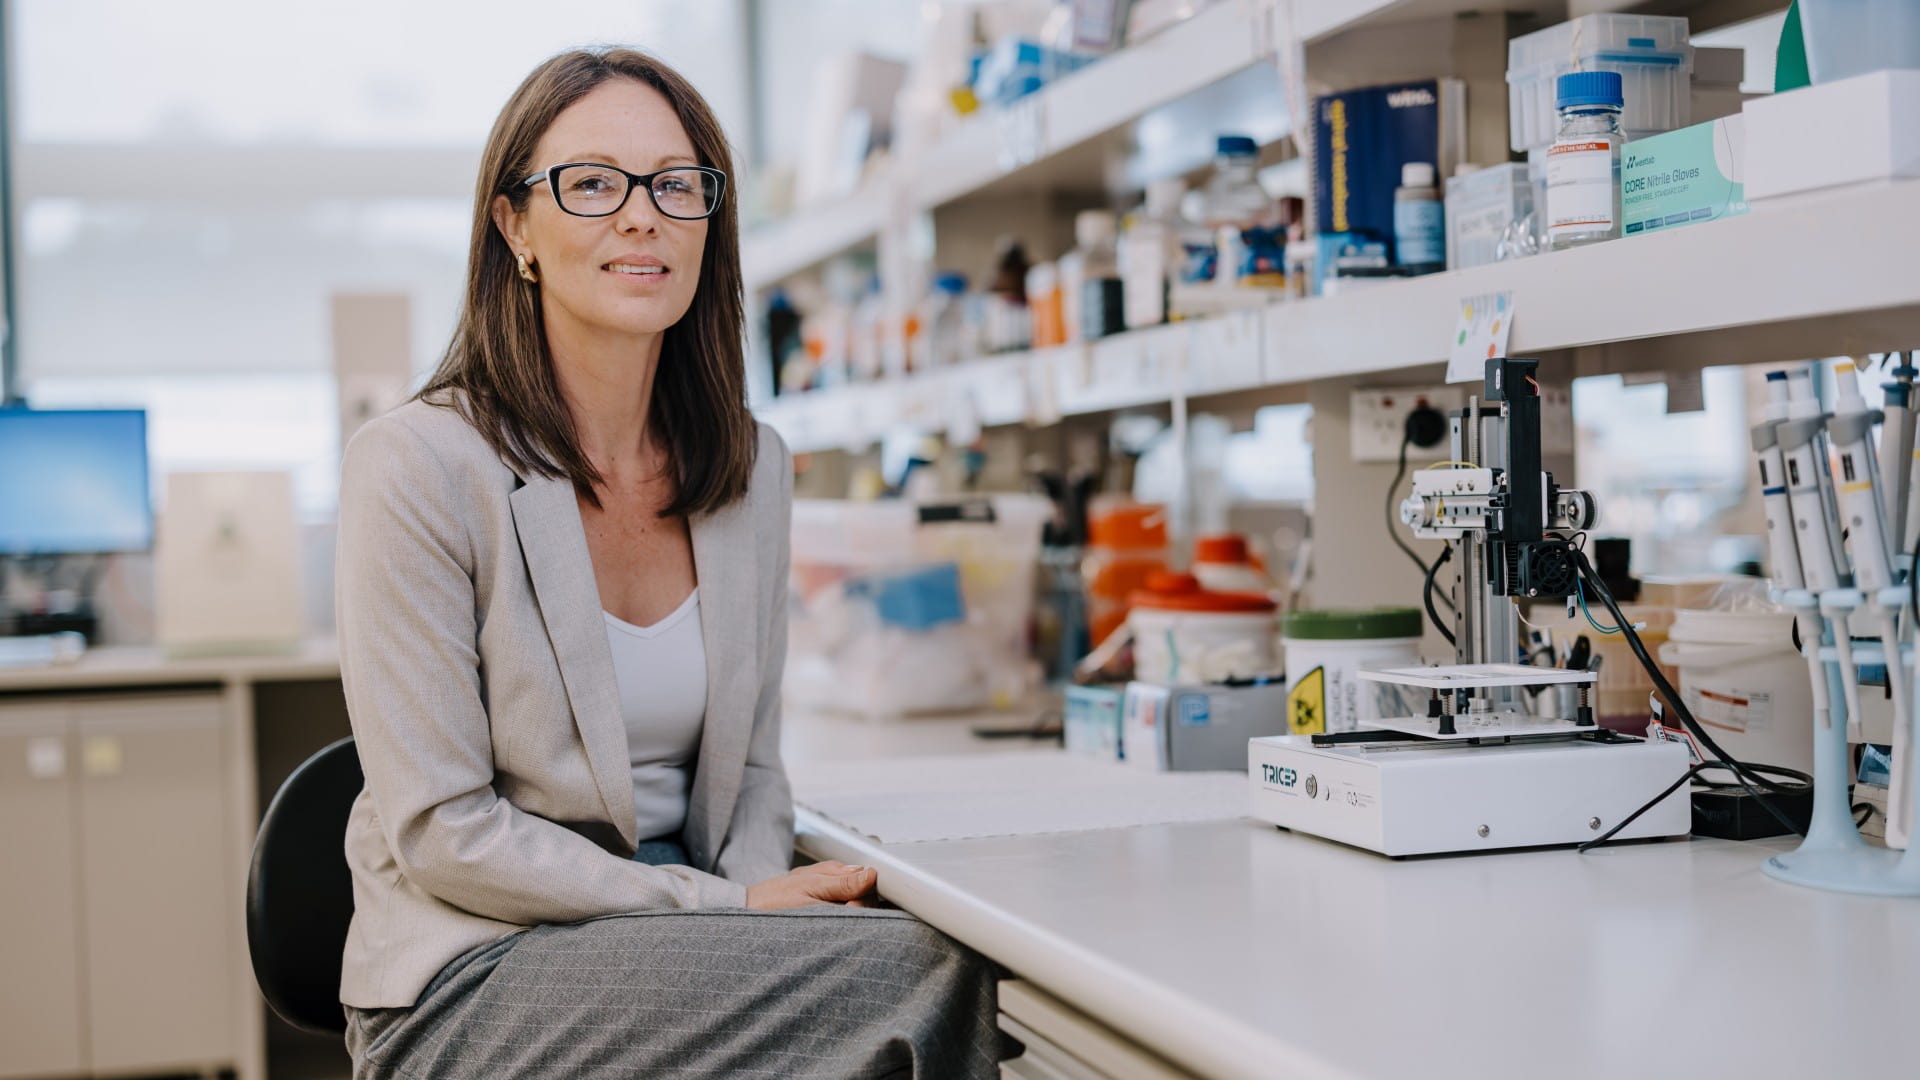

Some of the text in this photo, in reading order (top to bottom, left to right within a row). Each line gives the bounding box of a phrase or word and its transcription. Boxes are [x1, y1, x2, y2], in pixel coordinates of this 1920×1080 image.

[1625, 167, 1699, 194] CORE Nitrile Gloves
[1262, 763, 1298, 788] TRICEP
